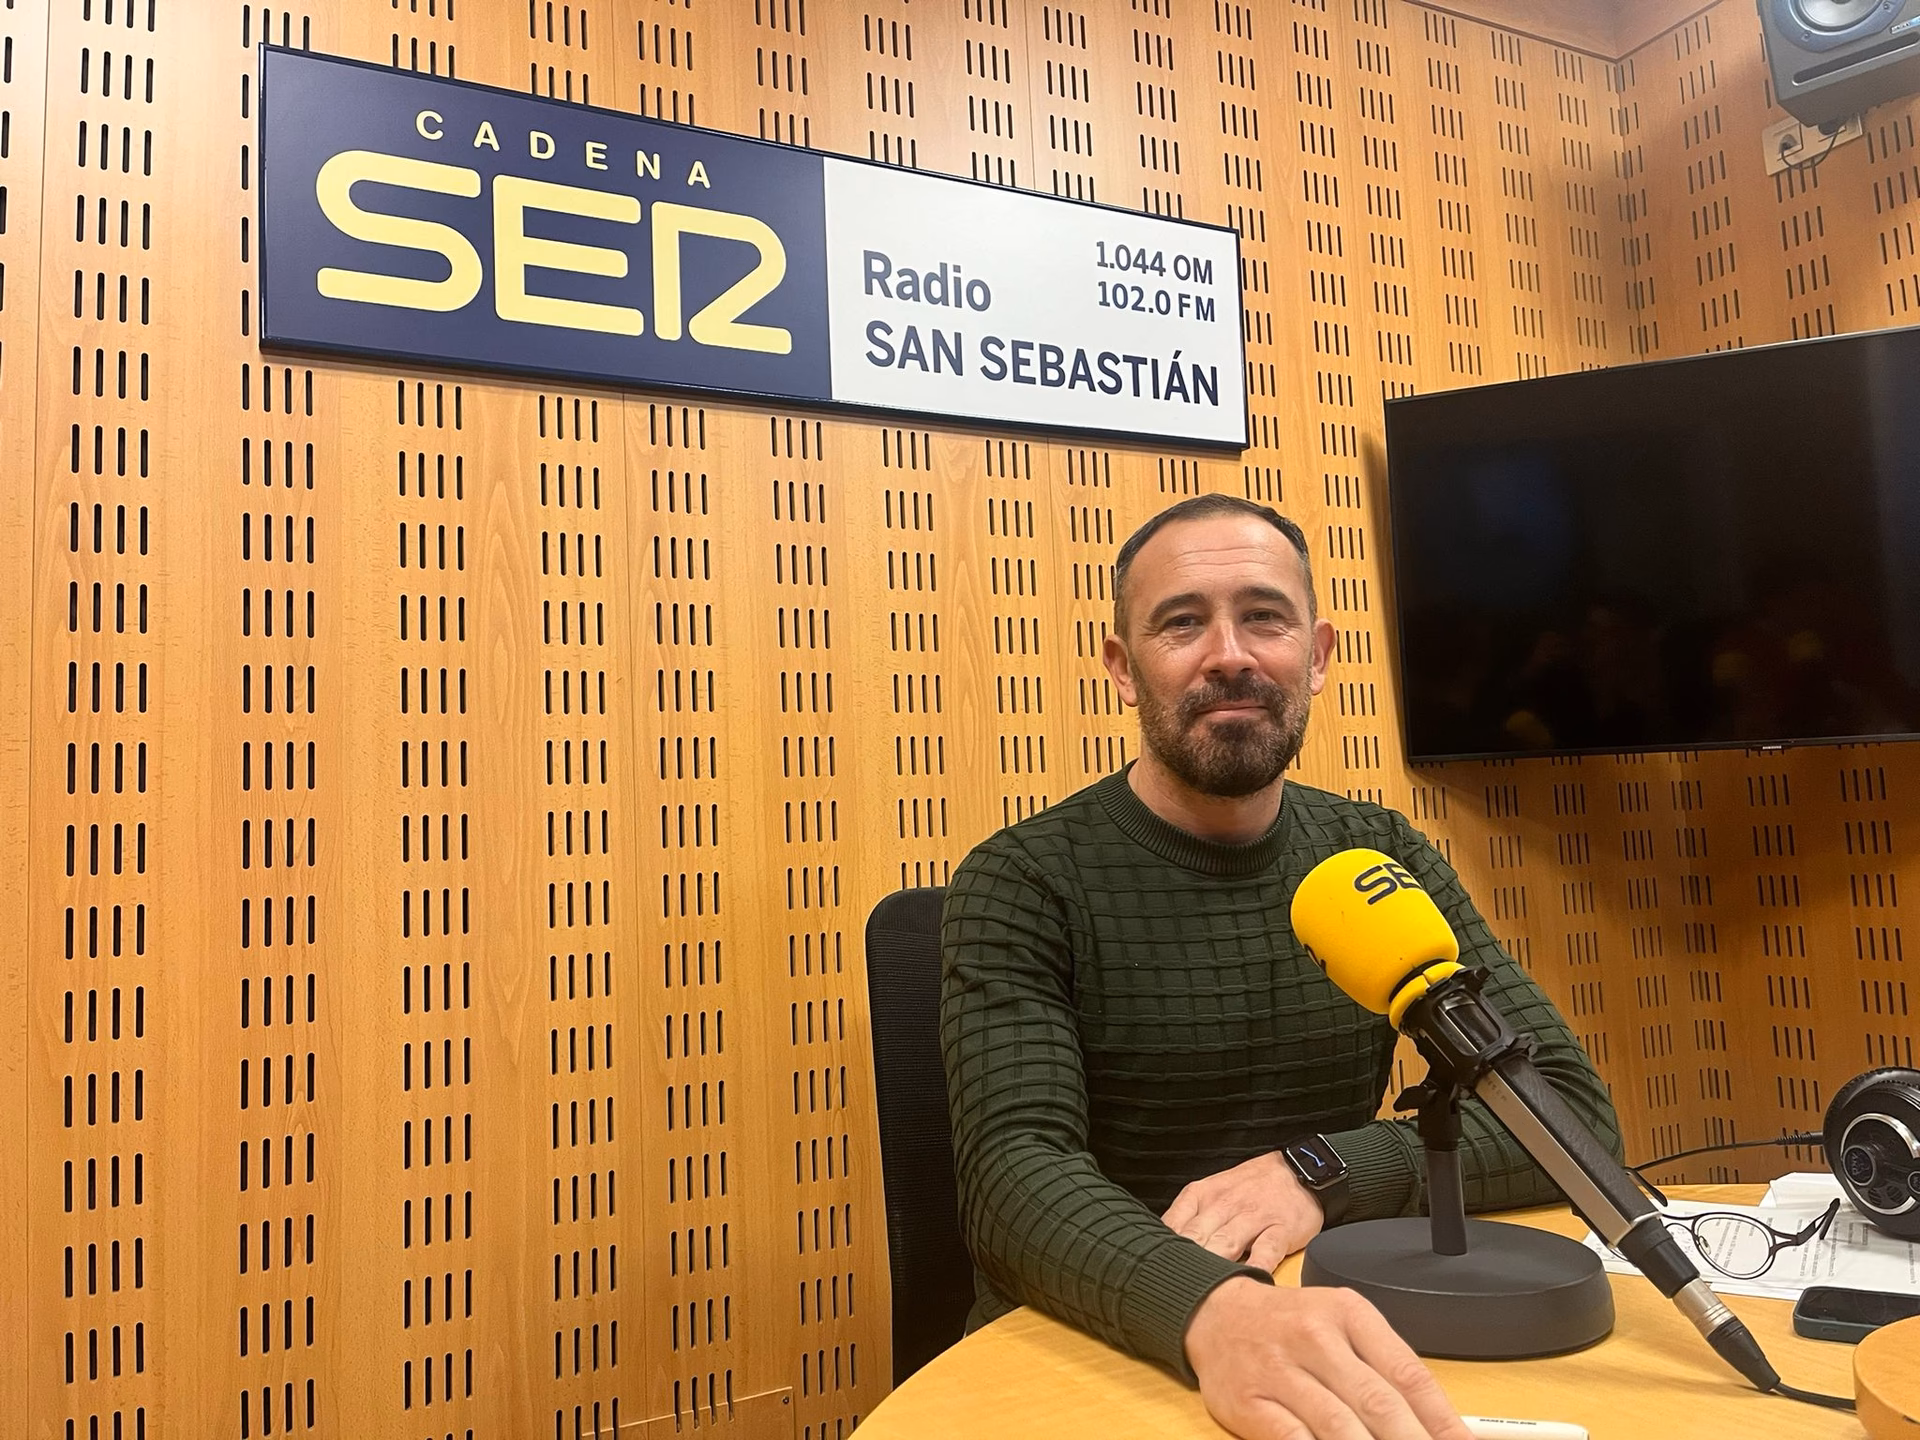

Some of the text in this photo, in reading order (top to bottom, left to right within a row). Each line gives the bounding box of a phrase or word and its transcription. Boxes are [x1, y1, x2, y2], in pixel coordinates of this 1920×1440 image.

[416, 110, 711, 189] CADENA
[315, 149, 793, 355] SER
[863, 249, 992, 312] Radio
[1096, 241, 1213, 286] 1.044 OM
[1097, 280, 1216, 323] 102.0 FM
[865, 320, 1219, 407] SAN SEBASTIÁN
